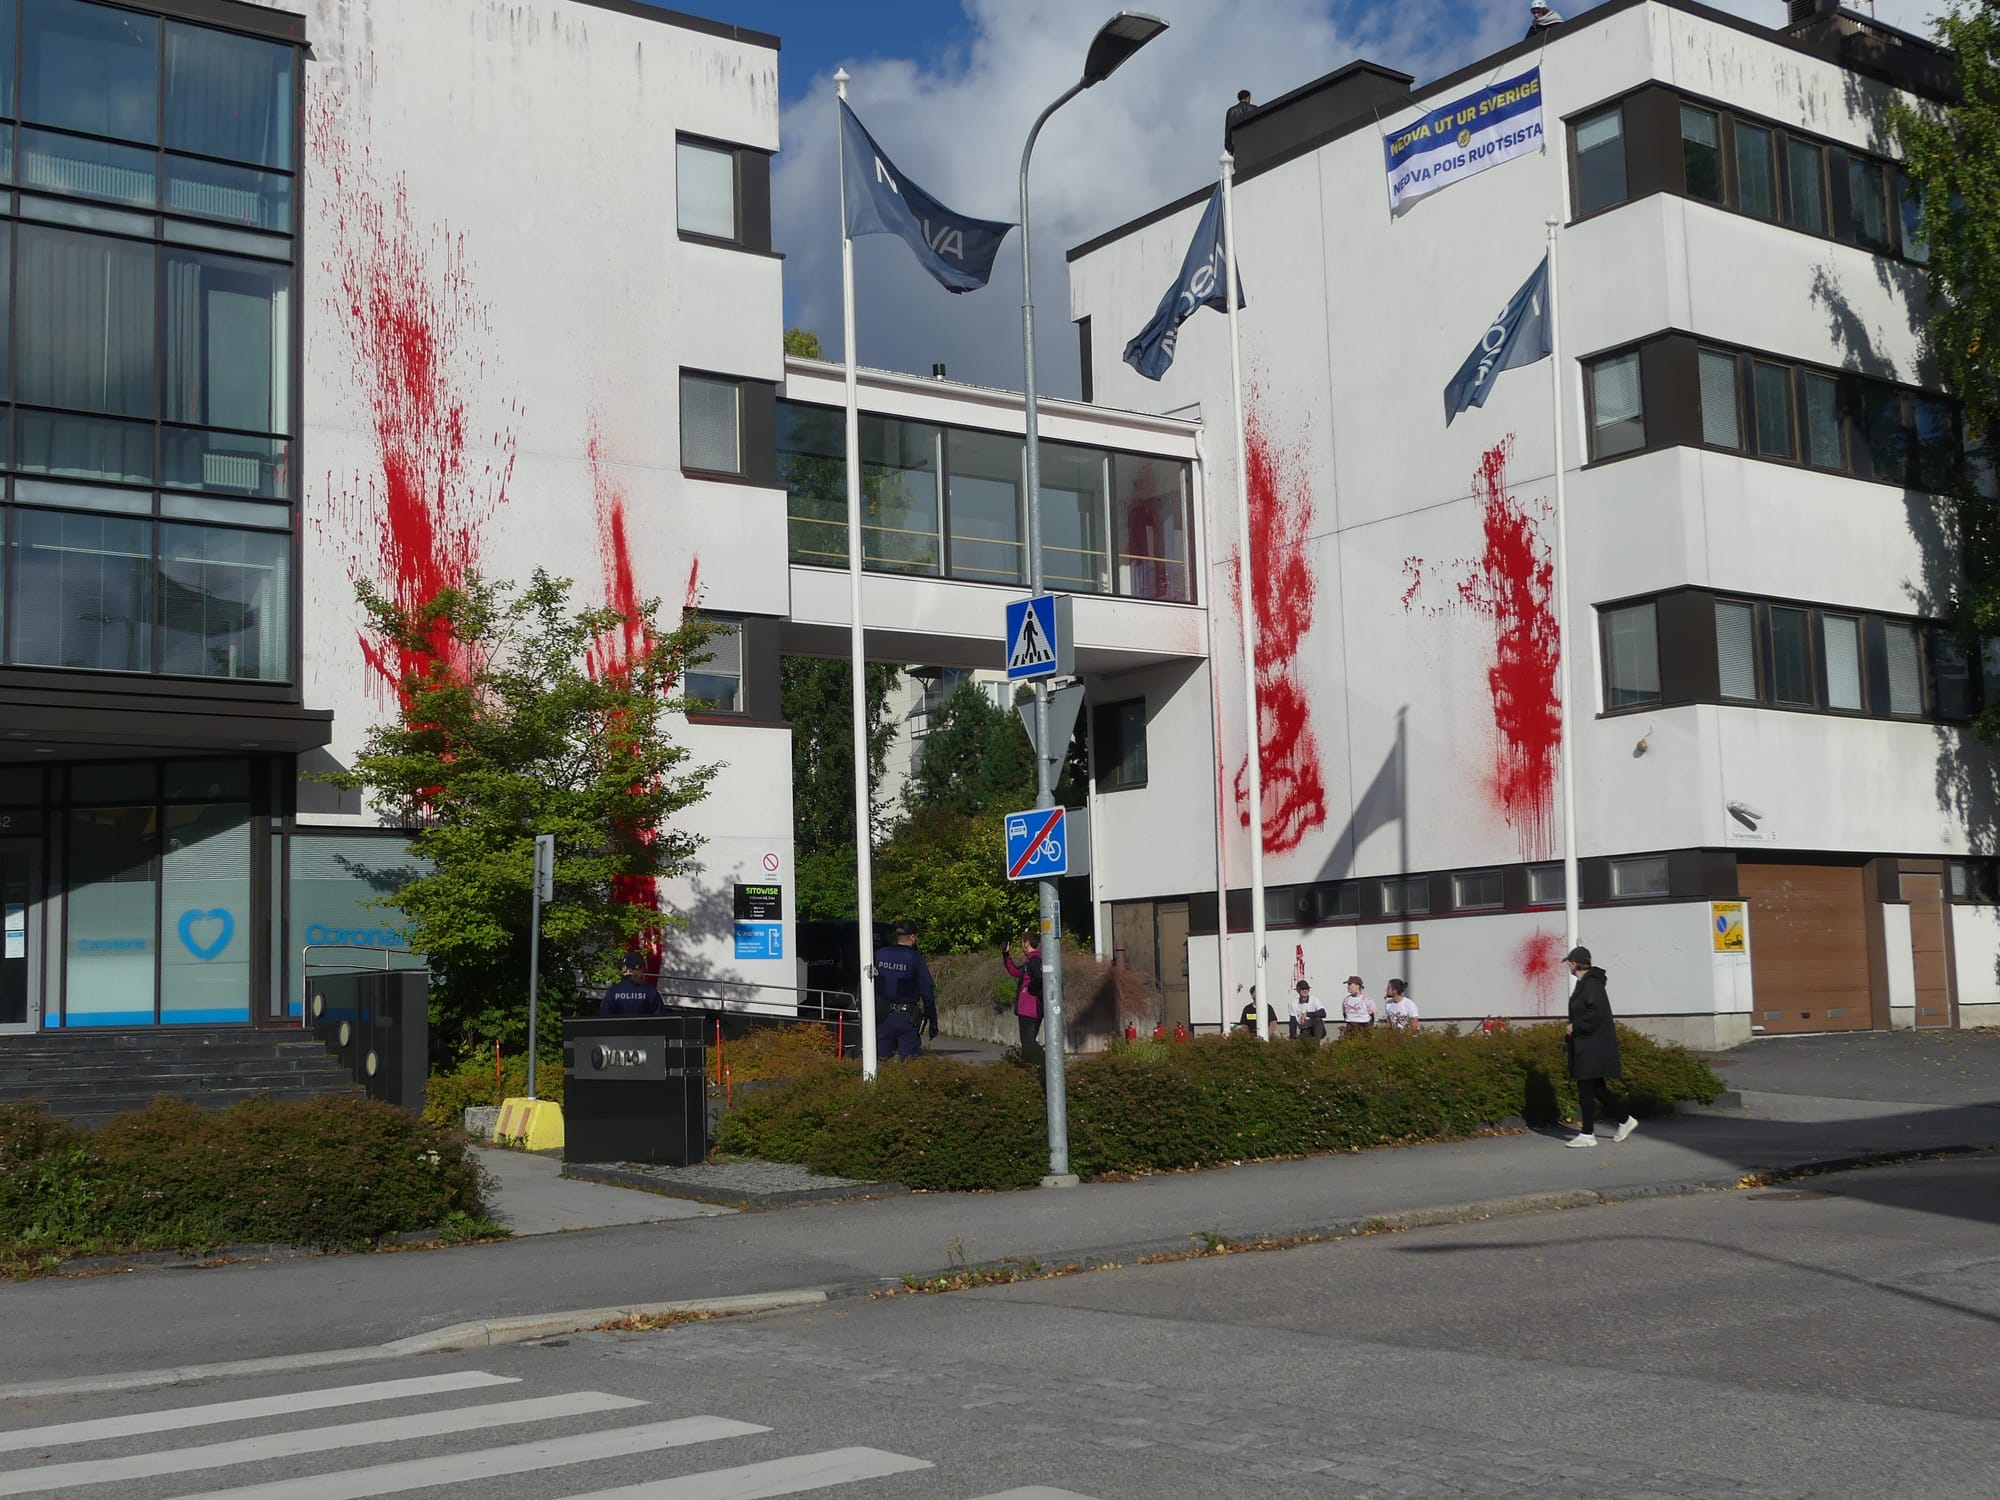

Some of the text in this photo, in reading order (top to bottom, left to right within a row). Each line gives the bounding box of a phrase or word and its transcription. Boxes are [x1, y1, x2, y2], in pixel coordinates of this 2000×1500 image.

[1390, 79, 1540, 156] NEOVA UT UR SVERIGE
[1393, 122, 1543, 196] NEOVA POIS RUOTSISTA
[878, 961, 908, 971] POLIISI
[615, 992, 646, 1000] POLIISI
